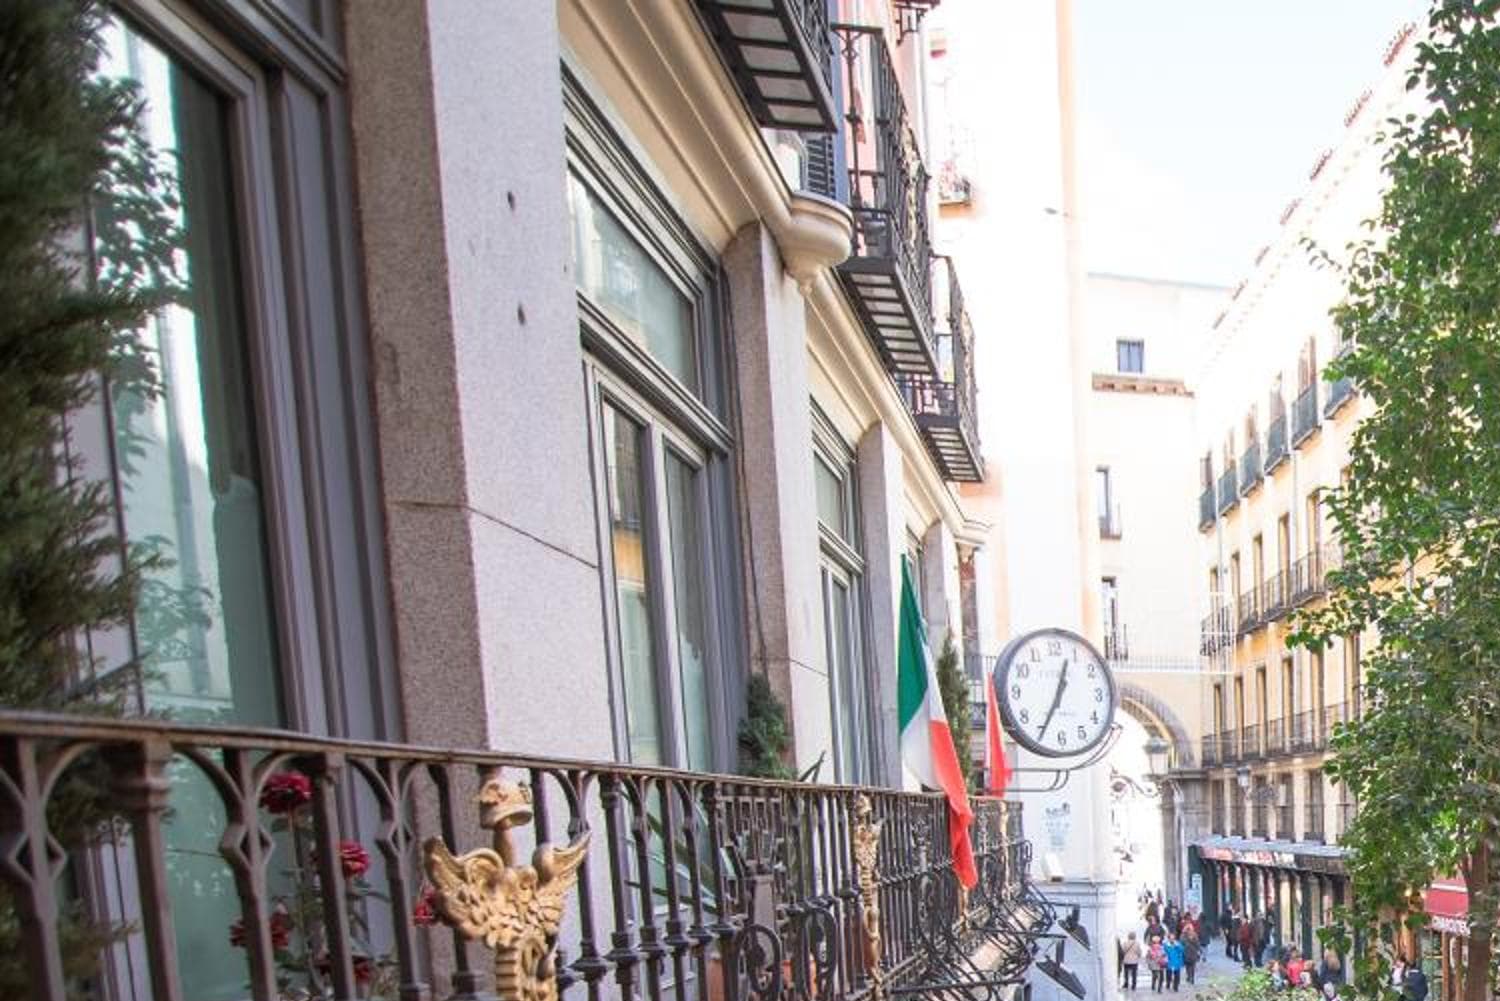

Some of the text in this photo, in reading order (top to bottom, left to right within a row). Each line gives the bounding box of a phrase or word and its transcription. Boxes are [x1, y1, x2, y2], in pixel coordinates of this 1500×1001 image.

[1030, 647, 1041, 663] 11
[1047, 641, 1061, 656] 12
[1016, 663, 1029, 679] 10
[1087, 663, 1096, 679] 2
[1011, 684, 1021, 700] 9
[1094, 688, 1103, 703] 3
[1019, 709, 1029, 725] 8
[1090, 711, 1099, 725] 4
[1057, 730, 1067, 746] 6
[1077, 725, 1087, 740] 5
